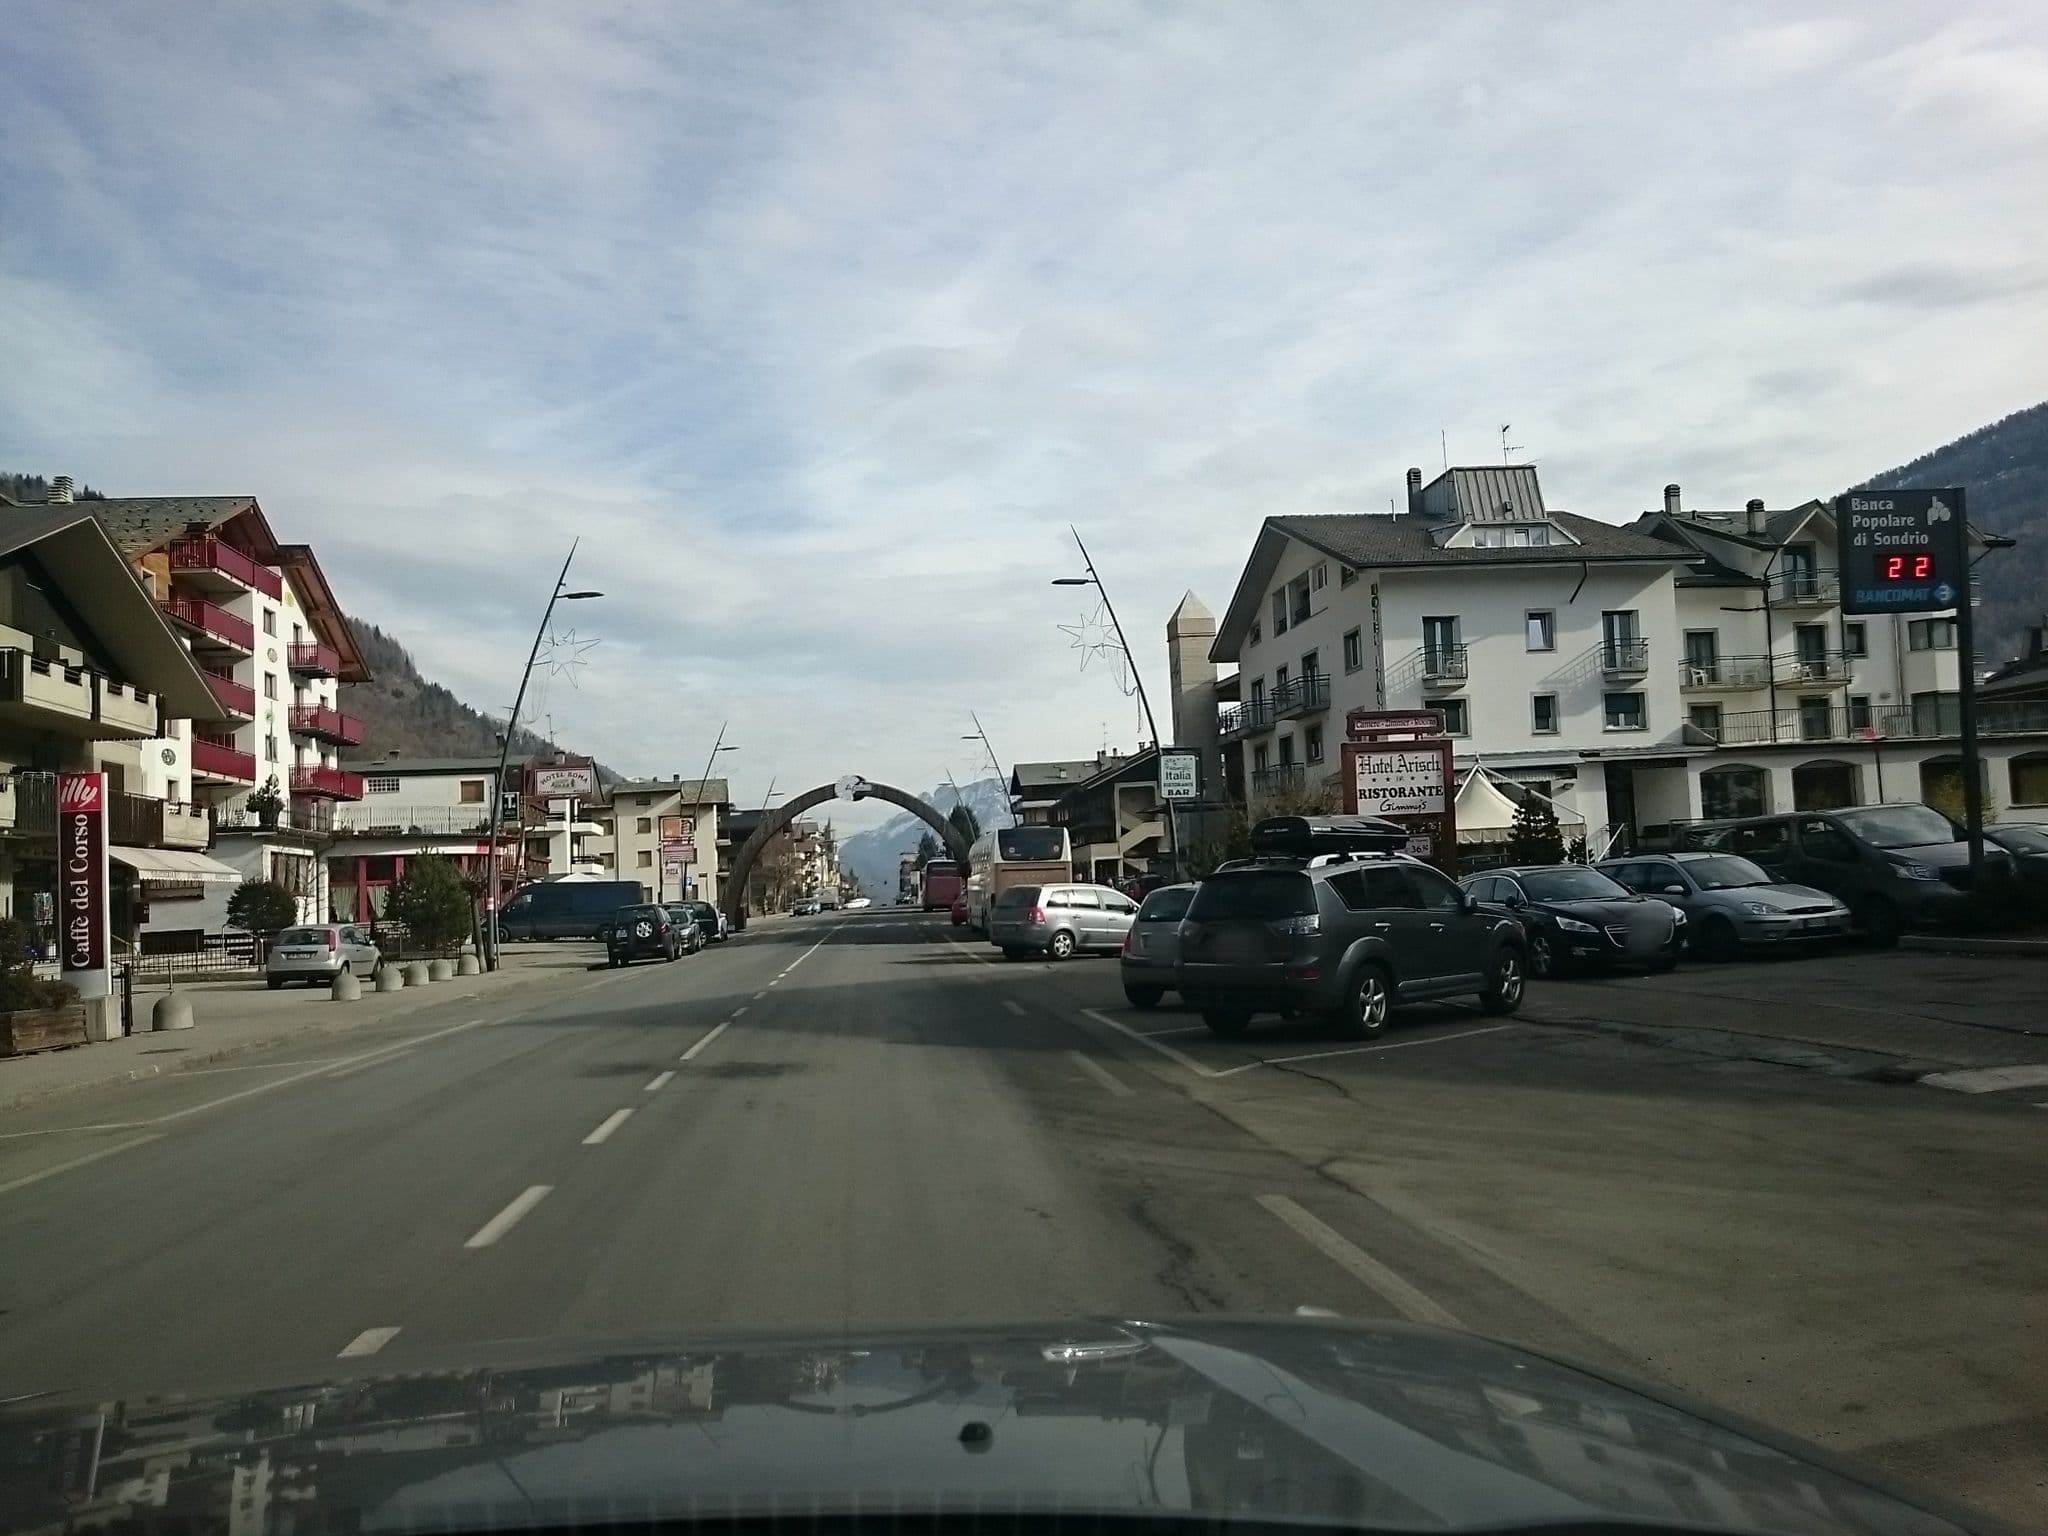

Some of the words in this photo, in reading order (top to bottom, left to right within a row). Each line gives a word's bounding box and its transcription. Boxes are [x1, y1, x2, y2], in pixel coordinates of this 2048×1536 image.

[1851, 498, 1894, 511] Banca
[1852, 514, 1915, 530] Popolare
[1854, 533, 1867, 546] di
[1874, 531, 1929, 546] Sondrio
[1856, 588, 1929, 603] BANCOMAT
[1358, 755, 1393, 774] Hotel
[540, 772, 565, 785] HOTEL
[567, 772, 588, 784] ROMA
[1165, 770, 1192, 780] Italia
[61, 778, 97, 808] illy
[1358, 785, 1444, 800] RISTORANTE
[69, 813, 89, 873] Corso
[70, 878, 89, 910] del
[71, 916, 90, 968] Caffè
